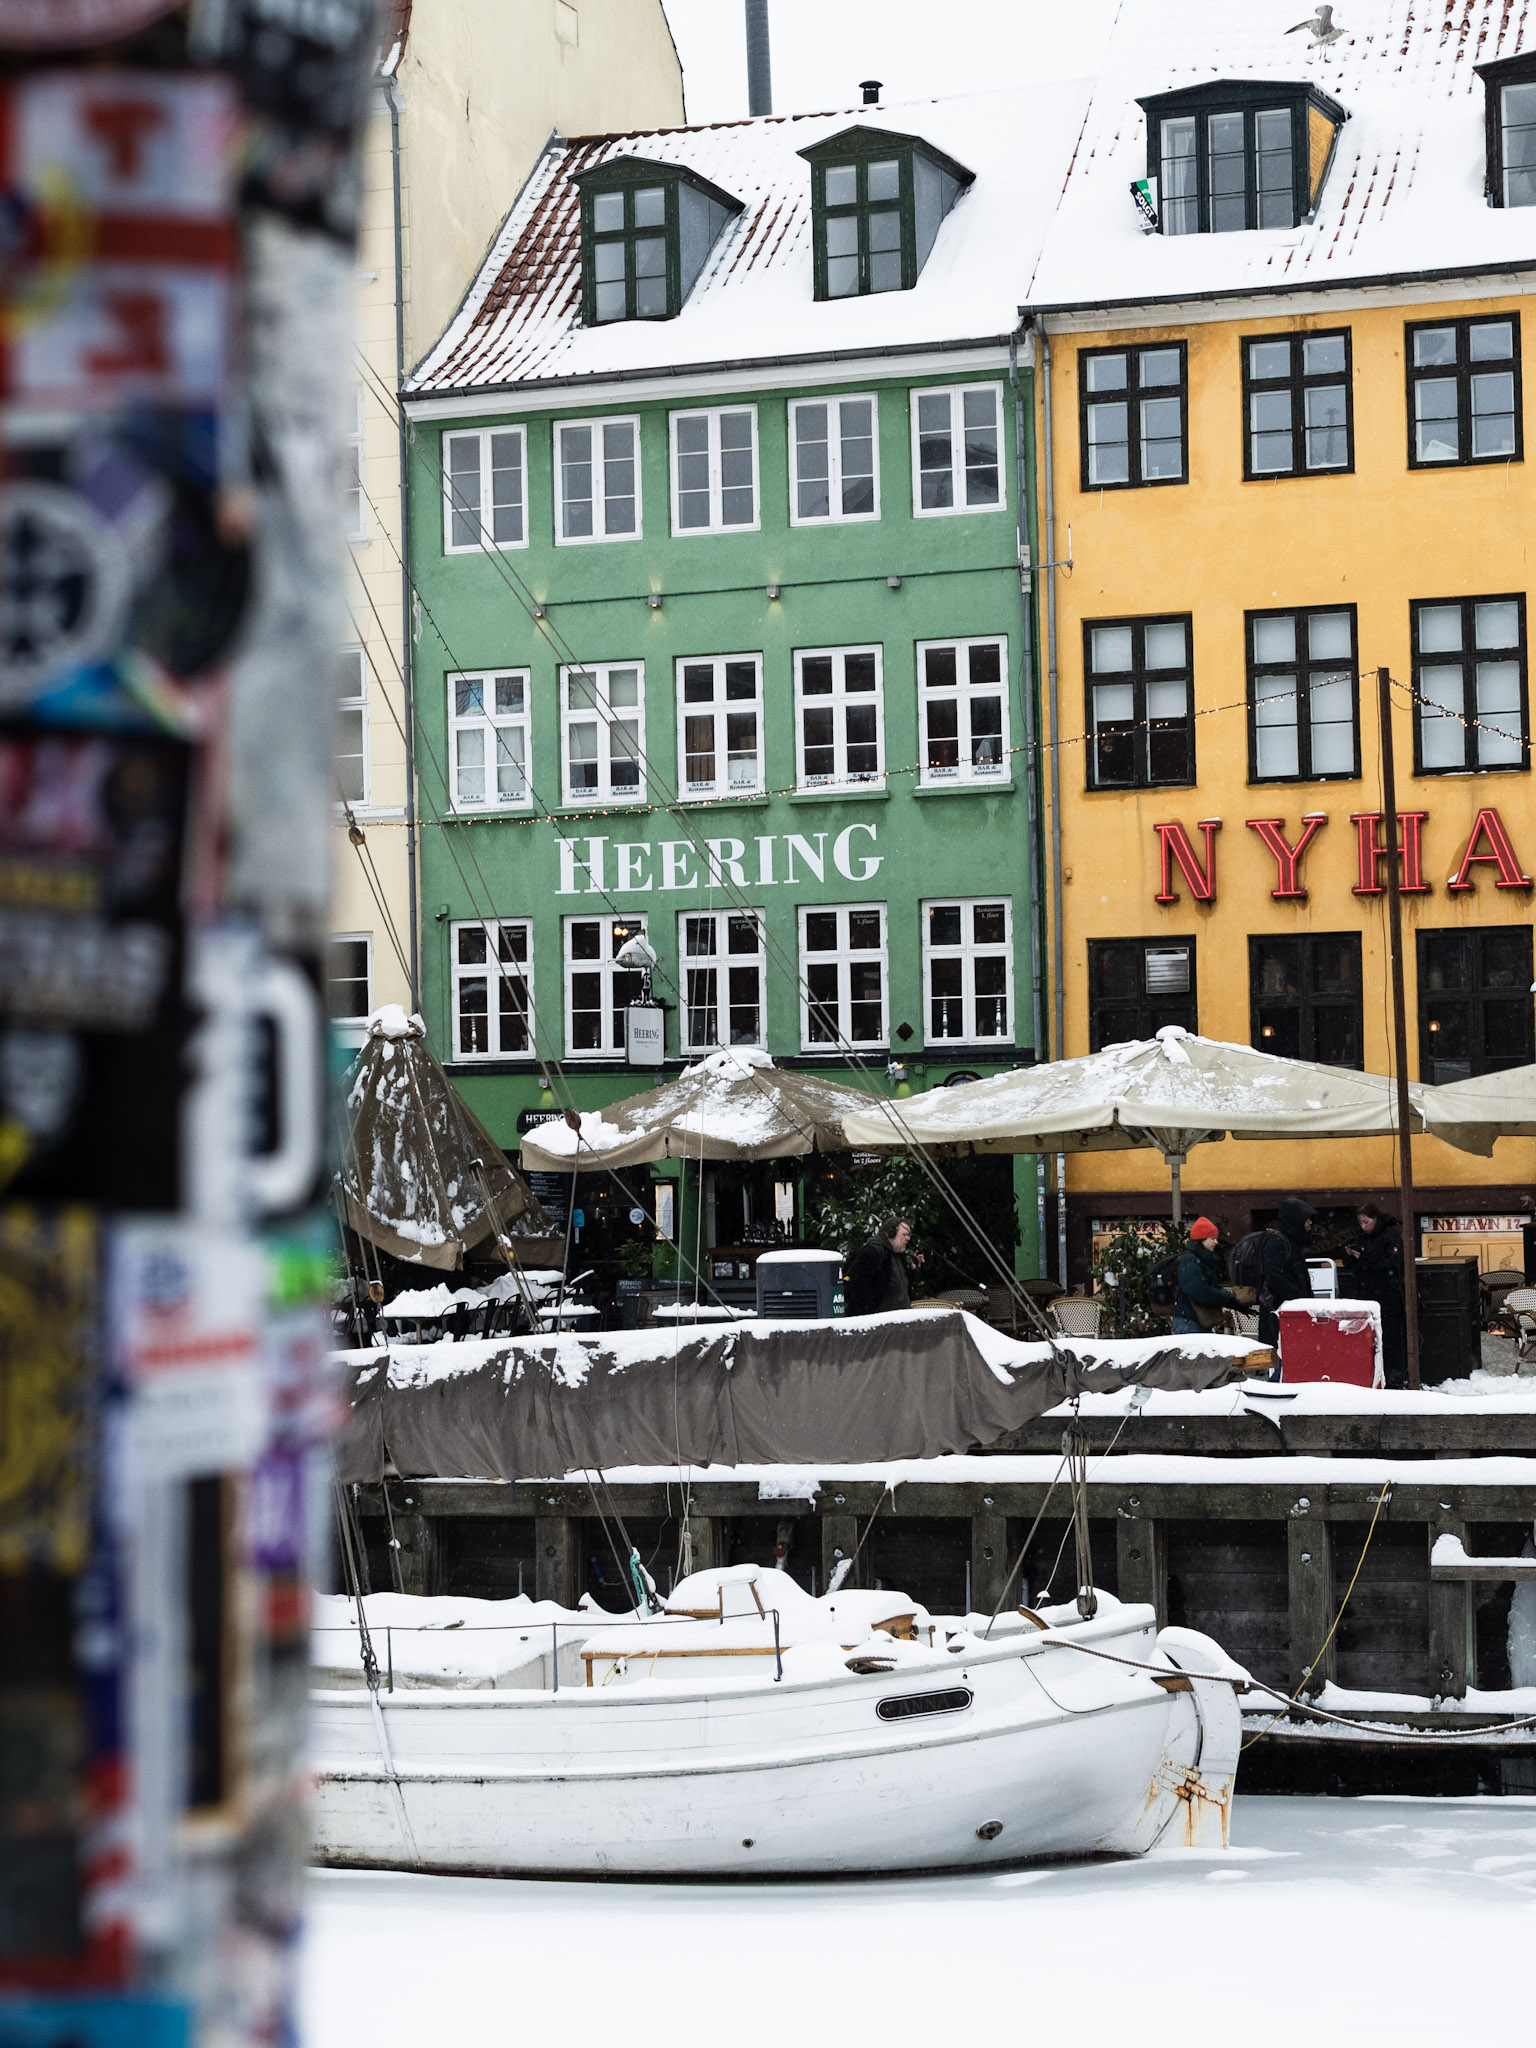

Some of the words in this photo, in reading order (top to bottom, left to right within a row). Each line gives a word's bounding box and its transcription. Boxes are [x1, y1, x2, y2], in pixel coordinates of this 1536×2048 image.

[1135, 191, 1155, 218] SOLGT
[553, 823, 885, 895] HEERING
[1153, 807, 1534, 903] NYHA
[634, 1028, 660, 1040] HEERING
[1432, 1218, 1500, 1230] NYHAVN
[1506, 1218, 1520, 1230] 17
